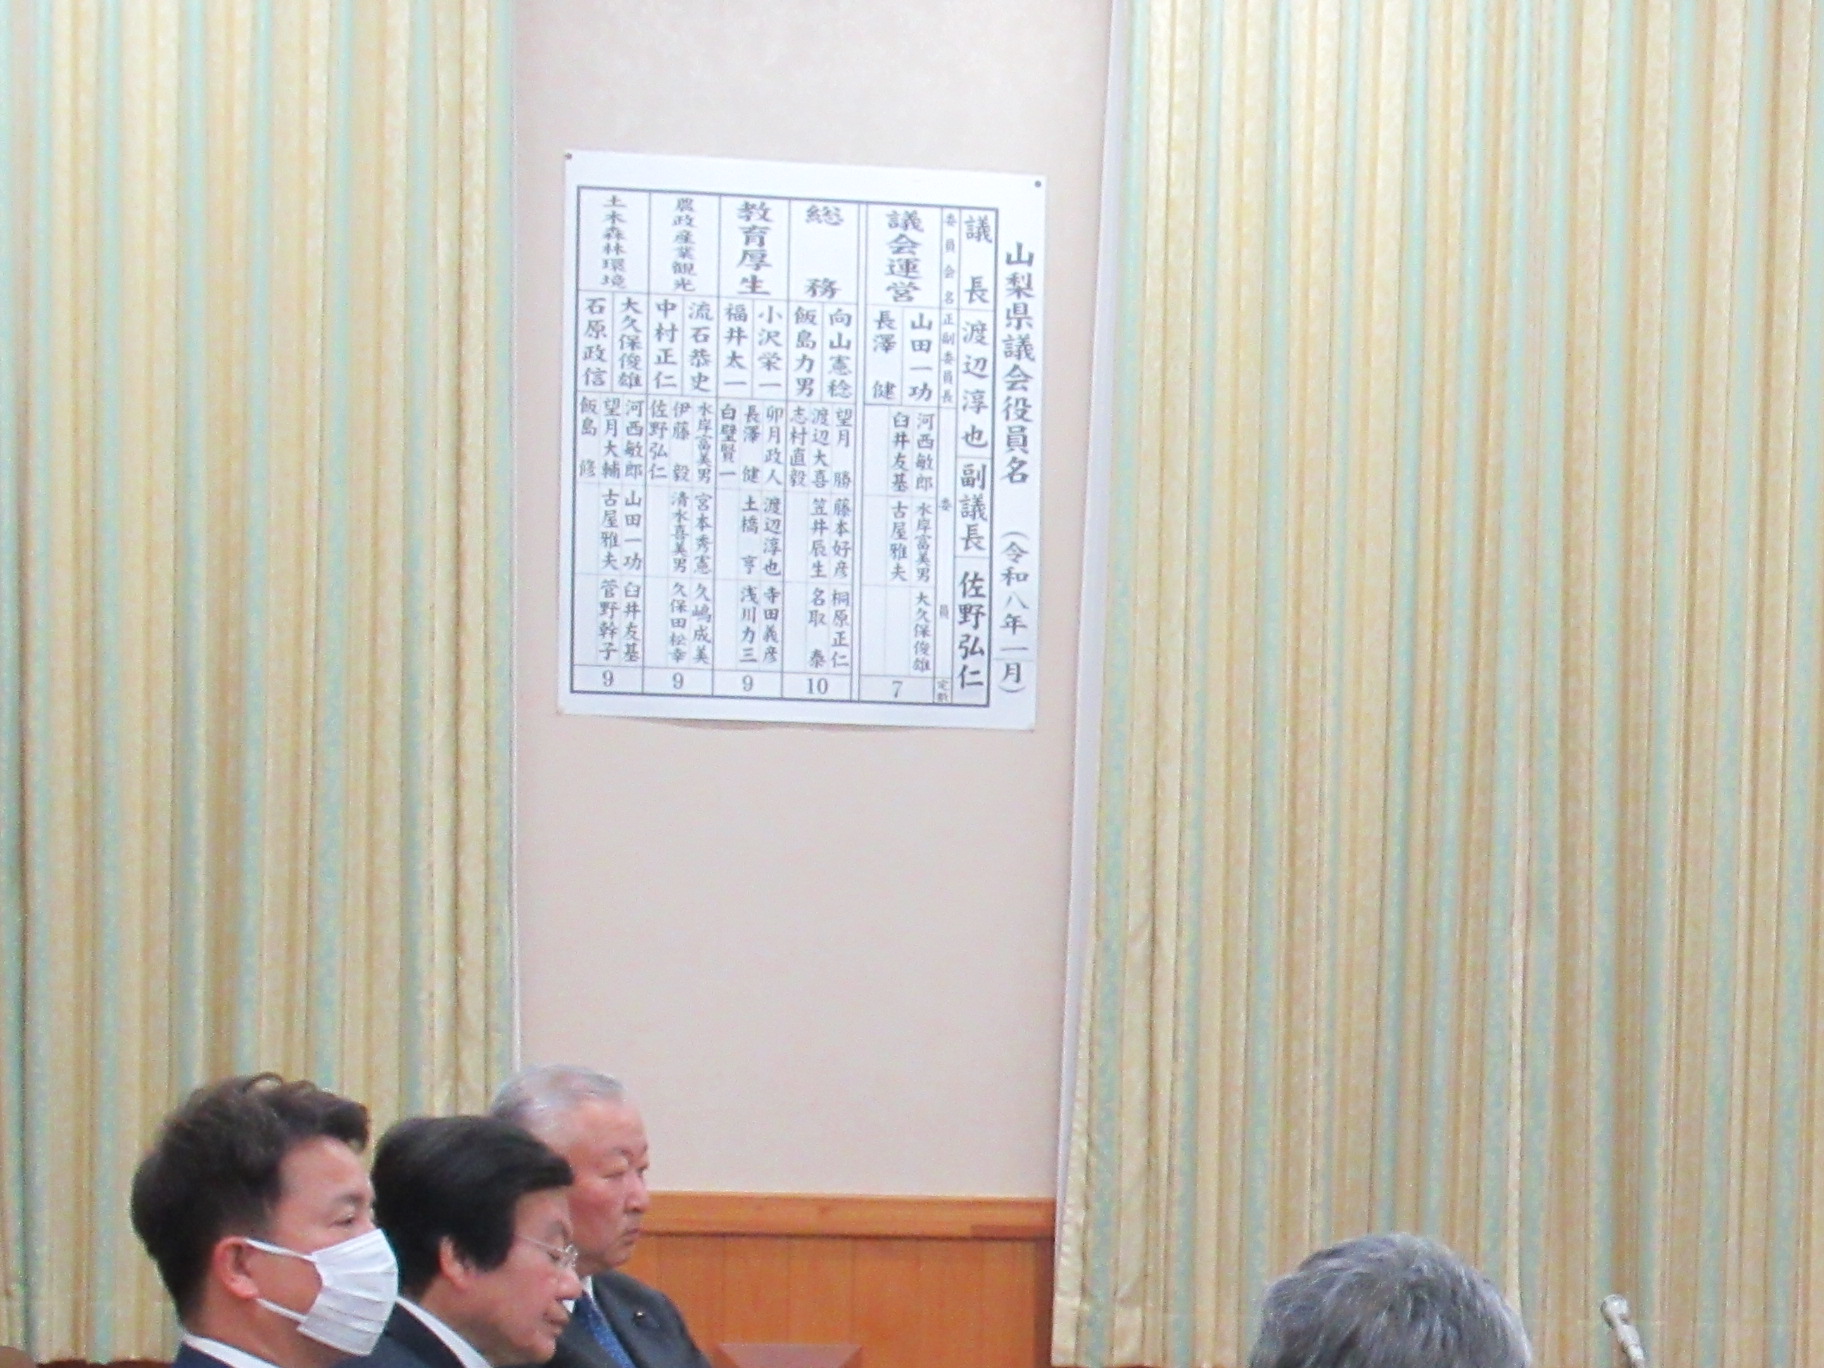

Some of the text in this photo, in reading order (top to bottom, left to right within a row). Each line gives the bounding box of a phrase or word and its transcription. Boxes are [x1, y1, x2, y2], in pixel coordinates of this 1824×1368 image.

[601, 194, 645, 391] 土木森林環境 大久保俊雄
[671, 197, 715, 393] 農政産業観光 流石恭史
[736, 200, 784, 388] 教育厚生 小沢栄一
[804, 203, 855, 400] 総務 向山憲稔
[943, 212, 956, 305] 委員会名
[582, 297, 609, 388] 石原政信
[653, 299, 679, 389] 中村正仁
[723, 303, 749, 385] 福井太一
[886, 210, 934, 402] 議会運営 山田一功
[793, 306, 820, 398] 飯島力男
[941, 313, 956, 404] 正副委員長
[1000, 242, 1036, 484] 山梨県議会役員名
[602, 397, 622, 480] 望月大輔
[624, 398, 645, 480] 河西敏郎
[809, 407, 831, 489] 渡辺大喜
[914, 412, 935, 493] 河西敏郎
[958, 214, 993, 689] 議長 渡辺淳也 副議長 佐野弘仁
[600, 488, 620, 571] 古屋雅夫
[623, 489, 643, 572] 山田一功
[649, 399, 685, 690] 佐野弘仁 9
[718, 402, 754, 692] 白壁賢一 9
[762, 406, 785, 664] 卯月政人 渡辺淳也 寺田義彦
[788, 405, 829, 696] 志村直毅 10
[808, 497, 829, 579] 笠井辰生
[831, 498, 852, 579] 藤本好彦
[889, 410, 911, 699] 臼井友基 古屋雅夫 7
[739, 584, 758, 664] 浅川力三
[911, 590, 932, 674] 大久保俊雄
[601, 670, 615, 688] 9
